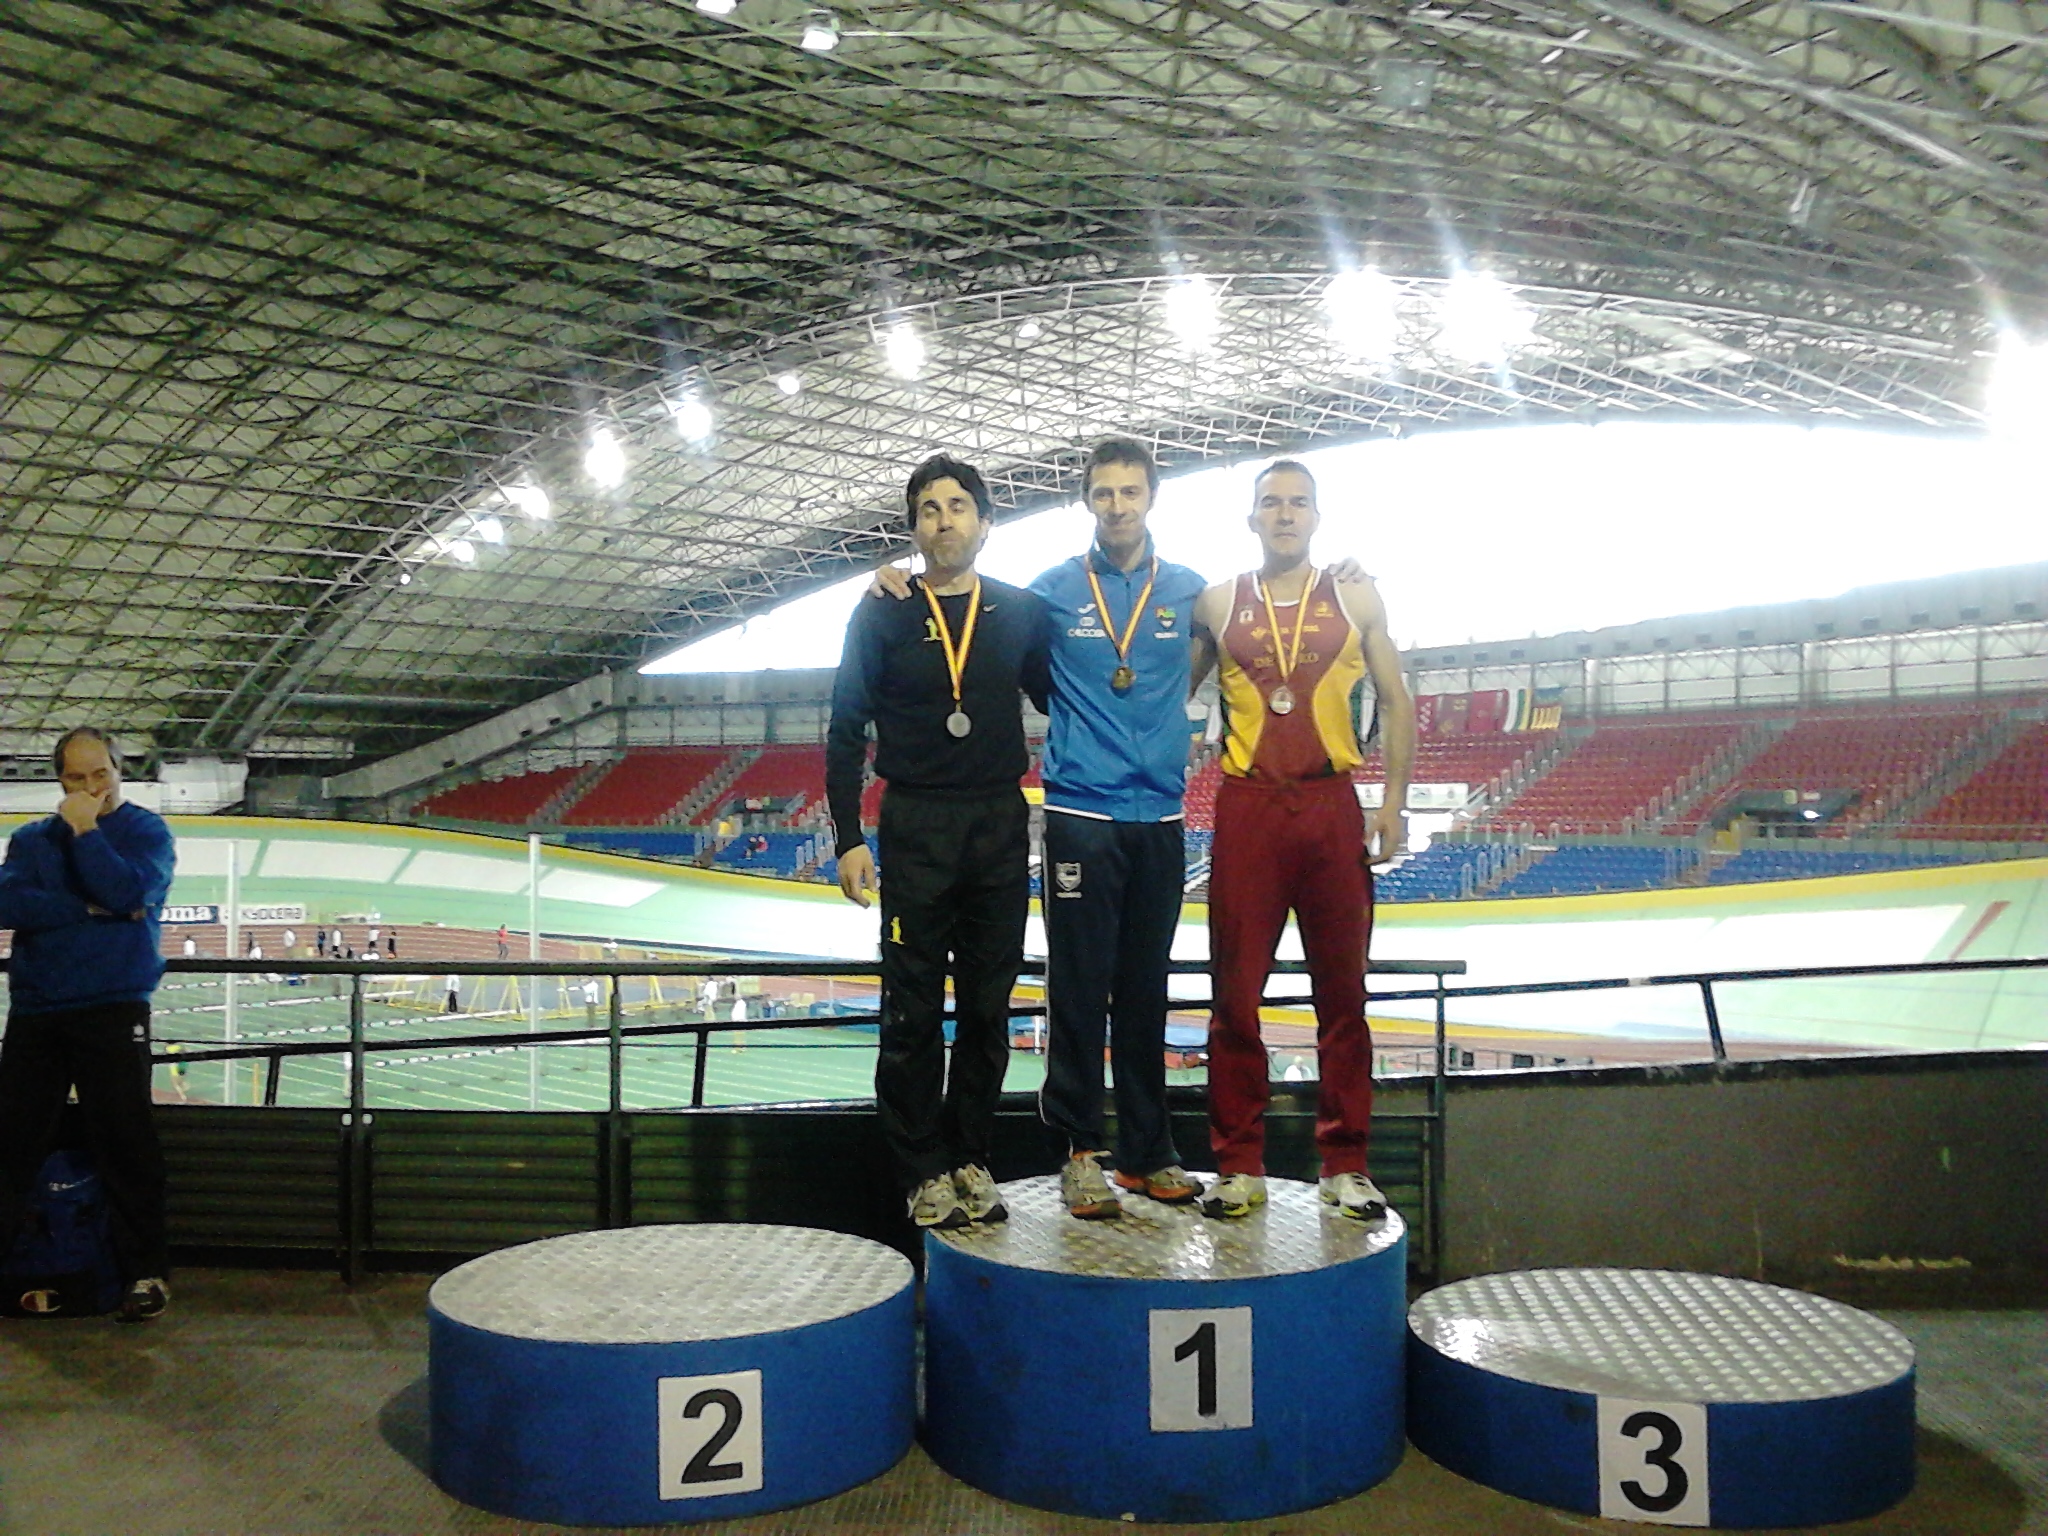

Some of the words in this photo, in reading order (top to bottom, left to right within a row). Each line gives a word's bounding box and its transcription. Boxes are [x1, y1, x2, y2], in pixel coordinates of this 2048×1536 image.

[1174, 1321, 1217, 1418] 1
[680, 1388, 744, 1485] 2
[1619, 1410, 1689, 1514] 3
